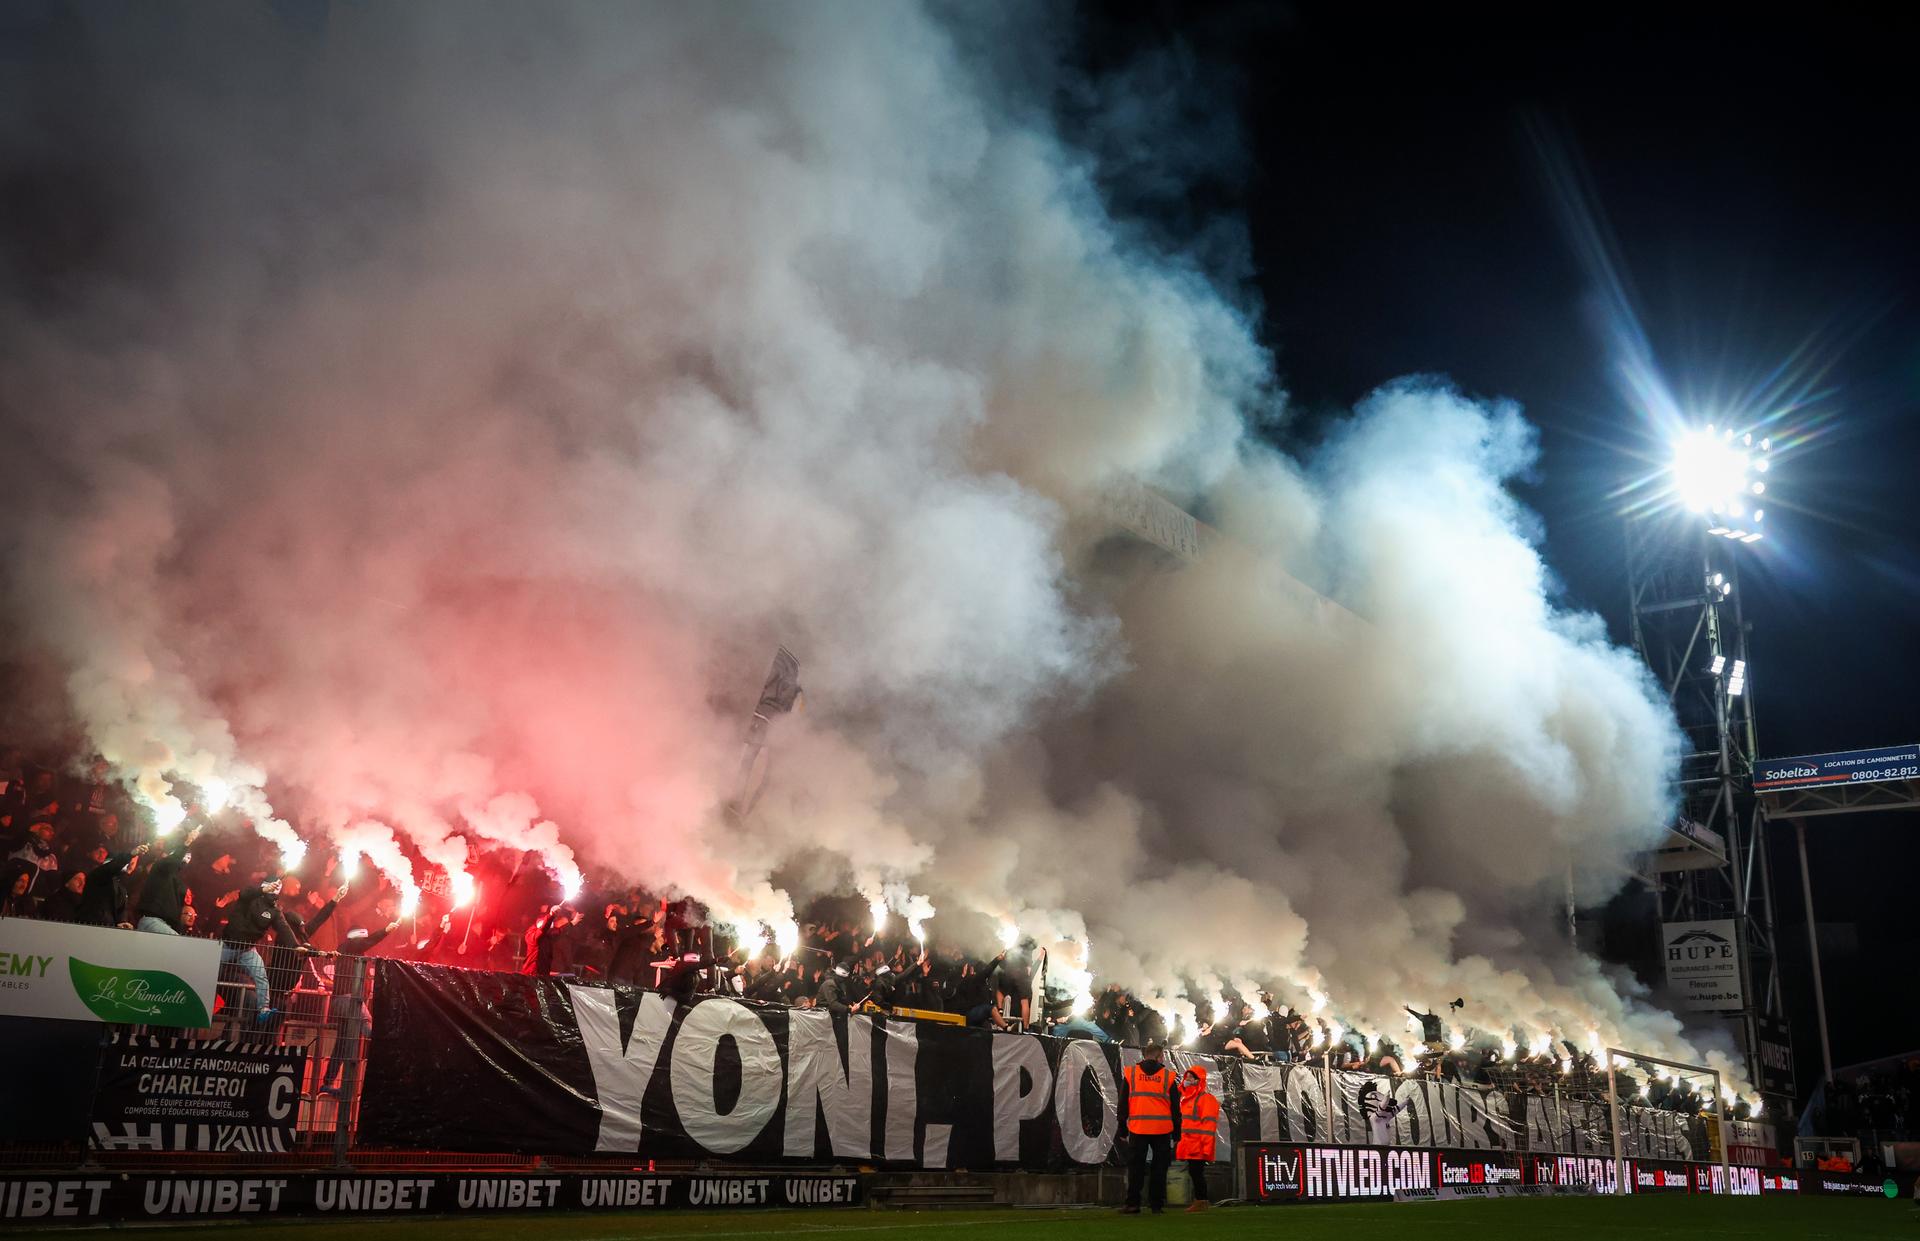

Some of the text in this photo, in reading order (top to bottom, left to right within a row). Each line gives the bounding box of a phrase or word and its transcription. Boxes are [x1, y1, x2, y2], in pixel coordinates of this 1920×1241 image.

[1824, 753, 1917, 768] LOCATION DE CAMIONNETTES
[1765, 767, 1818, 780] Sobeltax
[1851, 766, 1918, 780] 0800-82.812
[1668, 943, 1734, 961] HUPÉ
[90, 976, 187, 1004] La Primabelle
[1689, 980, 1718, 988] Fleurus
[120, 1054, 270, 1075] LA CELLULE FANCOACHING
[1760, 1040, 1792, 1071] UNIBET
[138, 1073, 247, 1098] CHARLEROI
[145, 1098, 158, 1106] UNE
[1803, 1152, 1814, 1160] 19
[1305, 1148, 1431, 1197] HTVLED.COM
[1442, 1162, 1469, 1184] Ecrans
[143, 1179, 287, 1215] UNIBET
[314, 1179, 435, 1211] UNIBET
[457, 1179, 562, 1209] UNIBET
[581, 1179, 672, 1208] UNIBET
[688, 1178, 770, 1206] UNIBET
[785, 1178, 857, 1204] UNIBET
[1403, 1187, 1440, 1197] UNIBET
[1453, 1186, 1490, 1195] UNIBET
